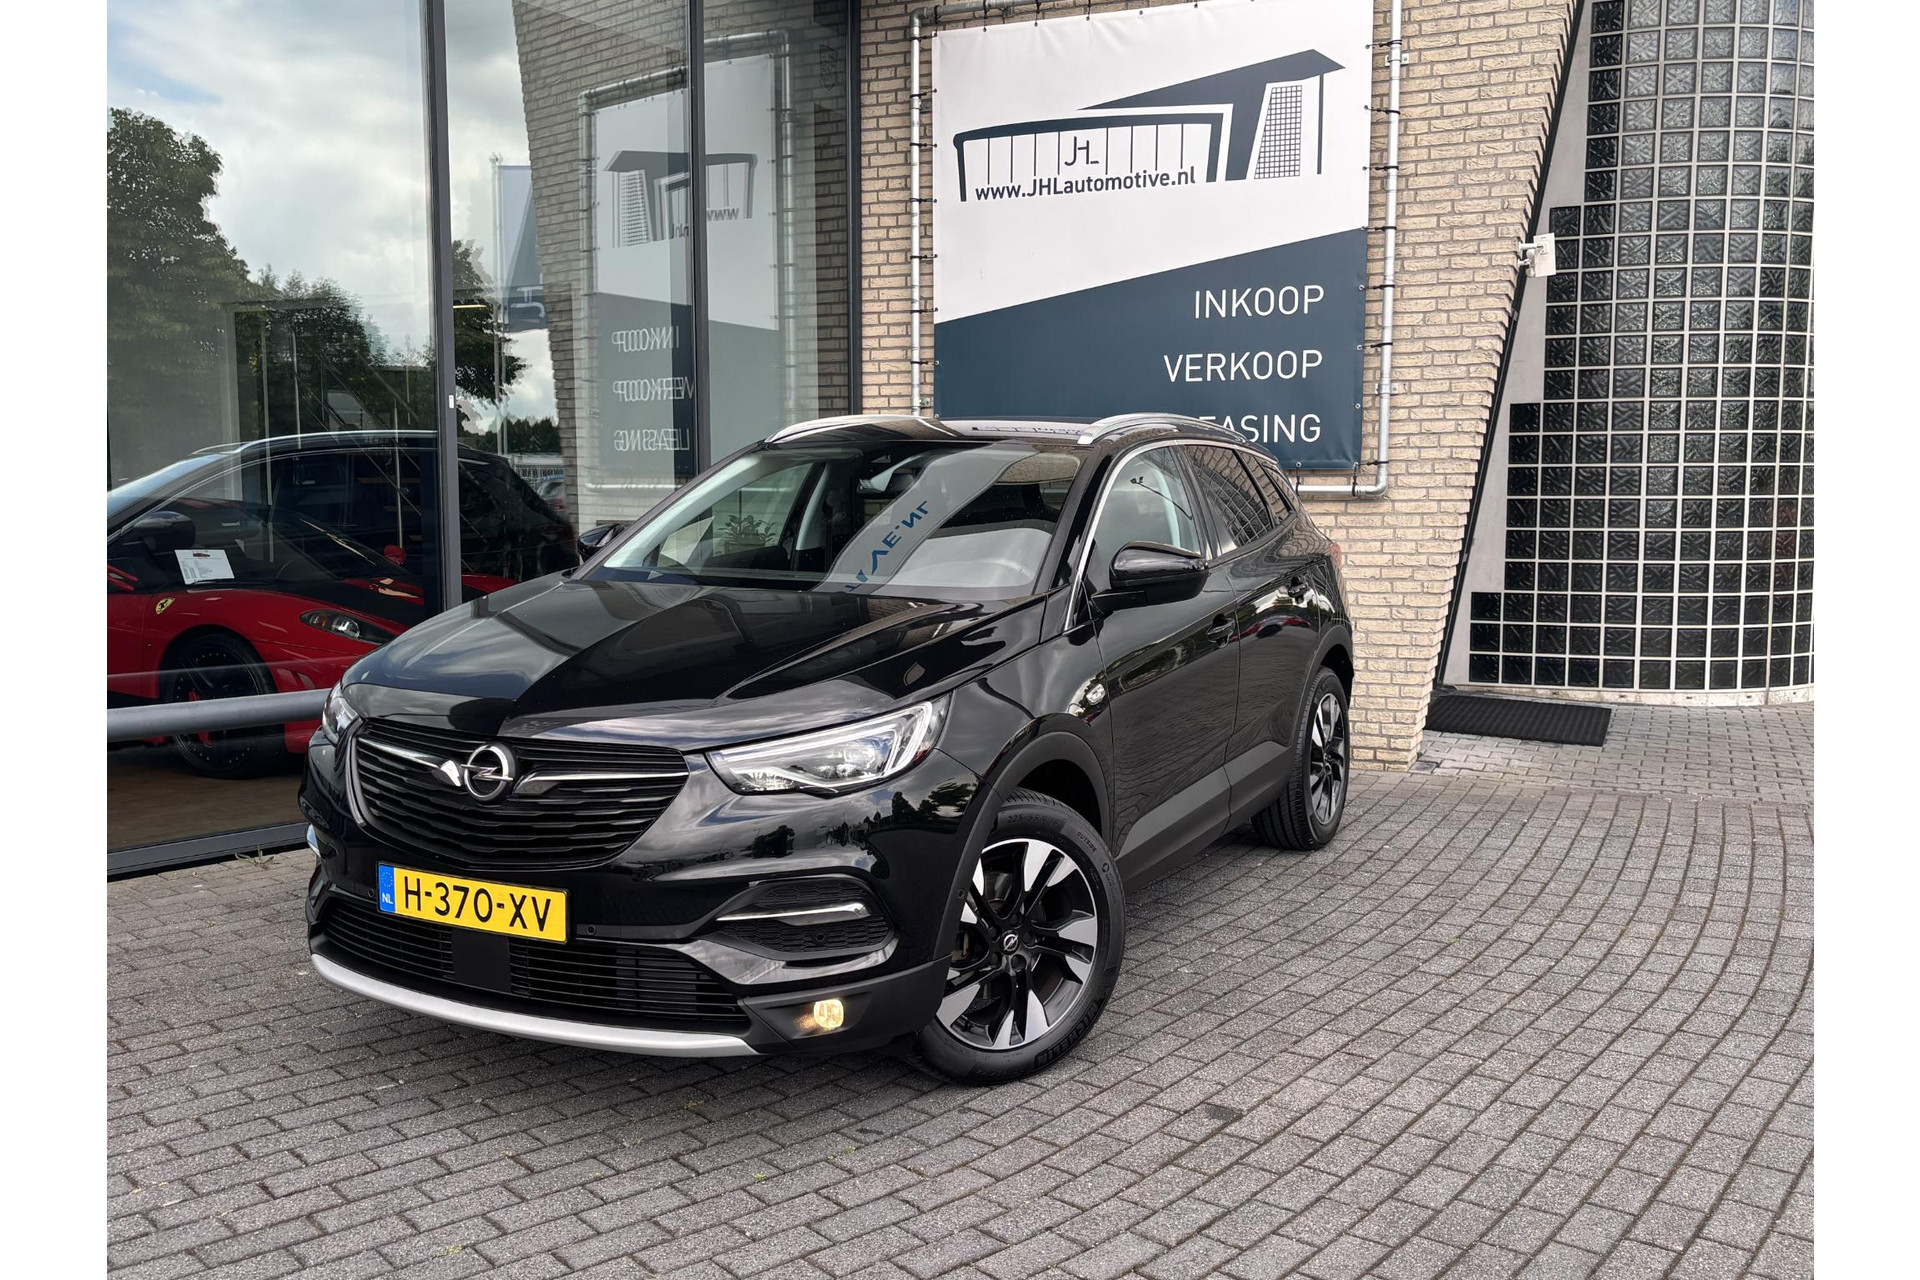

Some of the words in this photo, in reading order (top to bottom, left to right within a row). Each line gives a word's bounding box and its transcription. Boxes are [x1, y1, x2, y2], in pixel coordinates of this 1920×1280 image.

[1064, 136, 1100, 167] JHL
[975, 166, 1196, 200] www.JHLautomotive.nl
[1195, 285, 1325, 319] INKOOP
[1163, 350, 1323, 382] VERKOOP
[382, 892, 394, 905] NL
[404, 876, 552, 932] H-370-XV
